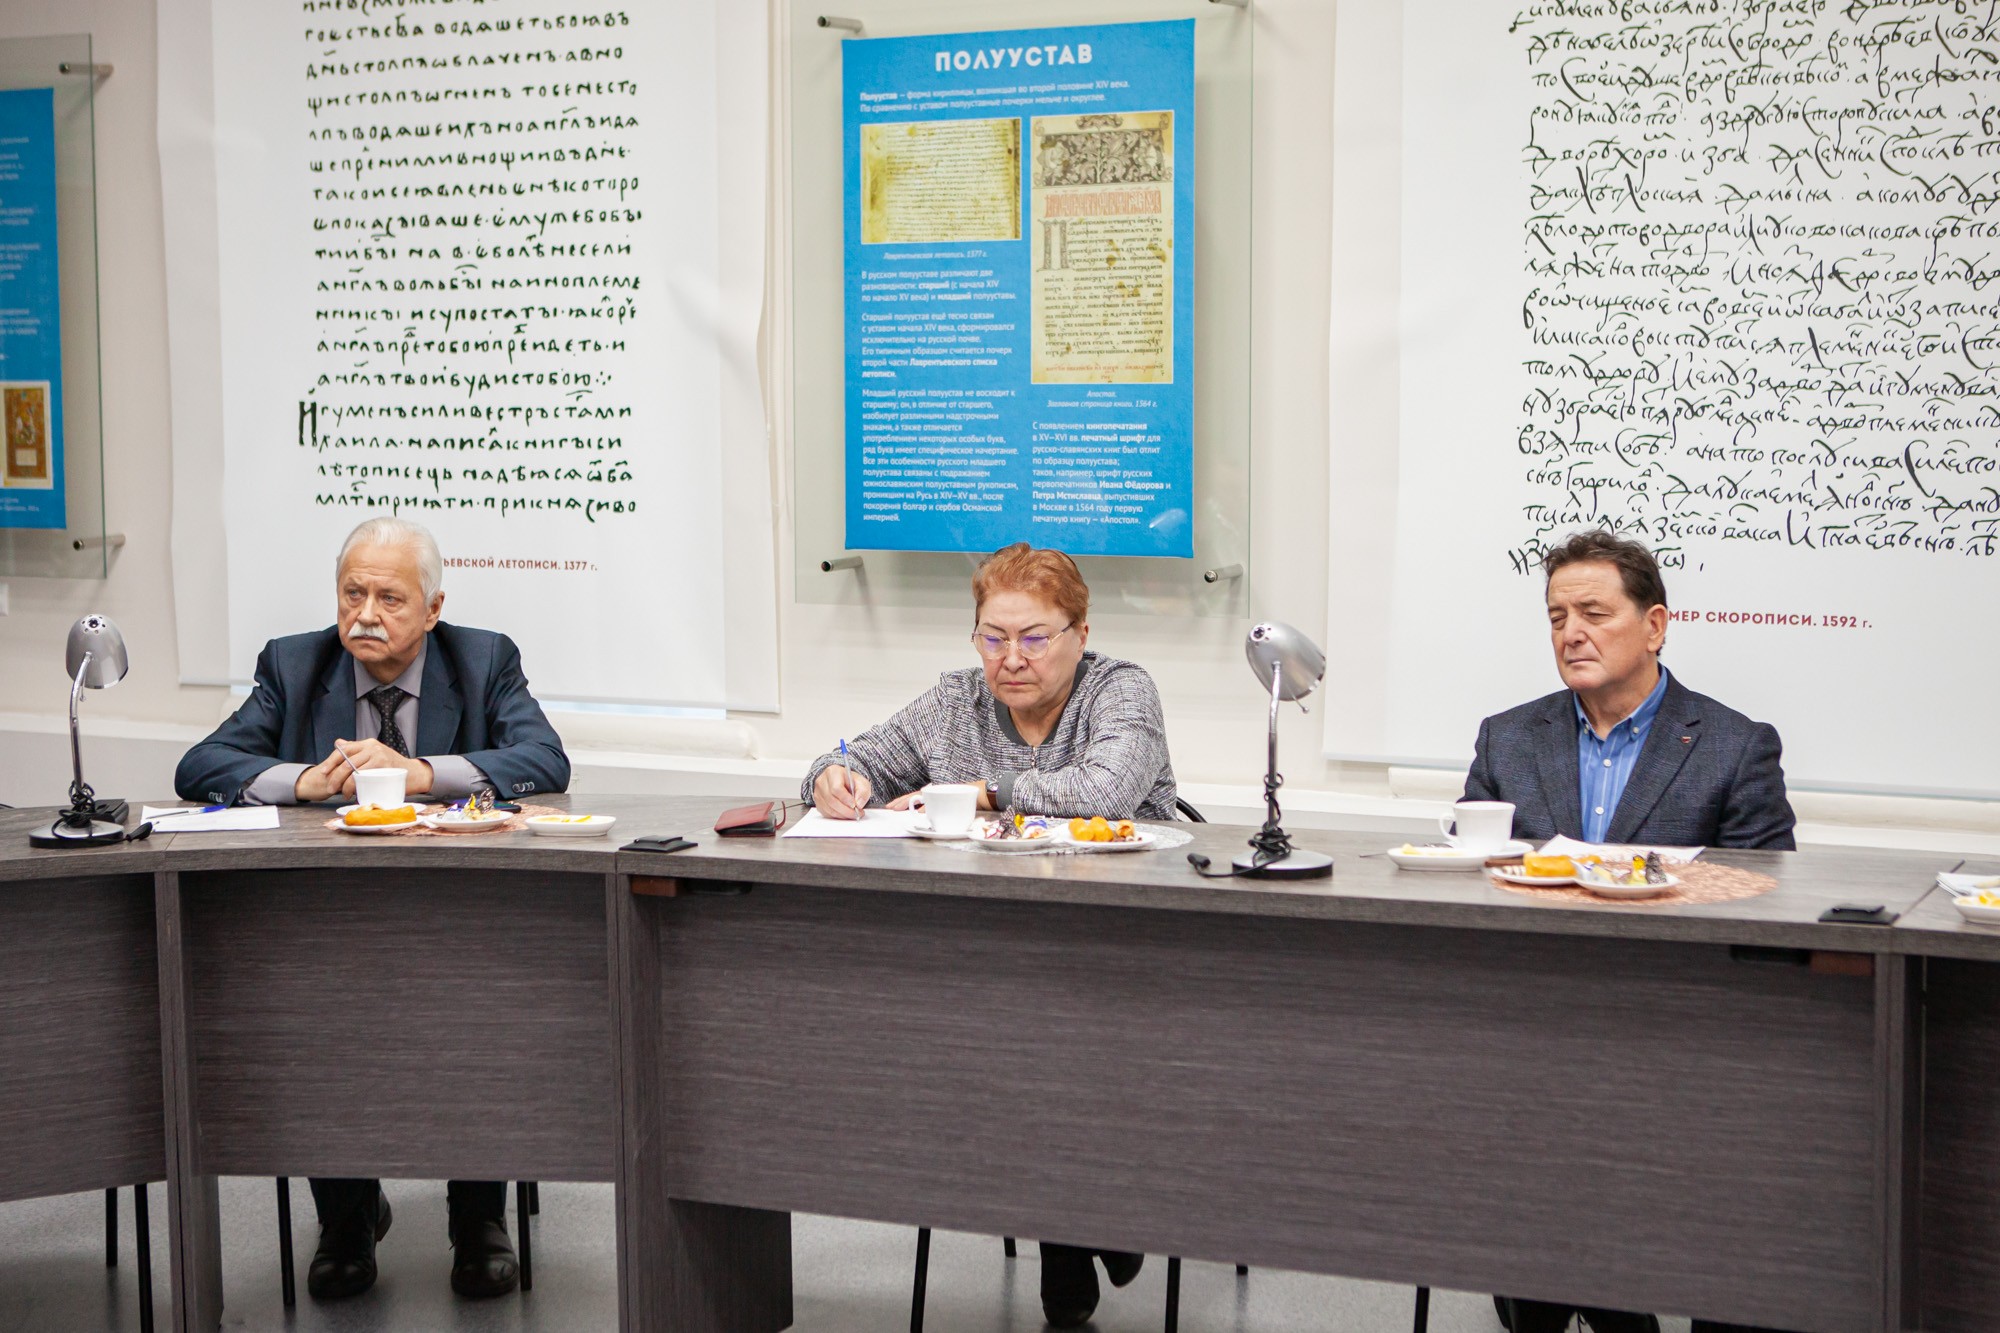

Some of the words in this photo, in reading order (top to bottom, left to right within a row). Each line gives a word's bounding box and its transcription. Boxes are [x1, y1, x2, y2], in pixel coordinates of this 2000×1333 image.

[935, 43, 1093, 72] ПОЛУУСТАВ
[444, 556, 494, 568] ЬЕВСКОЙ
[498, 559, 561, 570] ЛЕТОПИСИ.
[564, 561, 587, 570] 1377
[1668, 610, 1700, 622] МЕР
[1706, 611, 1817, 626] СКОРОПИСИ.
[1823, 616, 1857, 628] 1592
